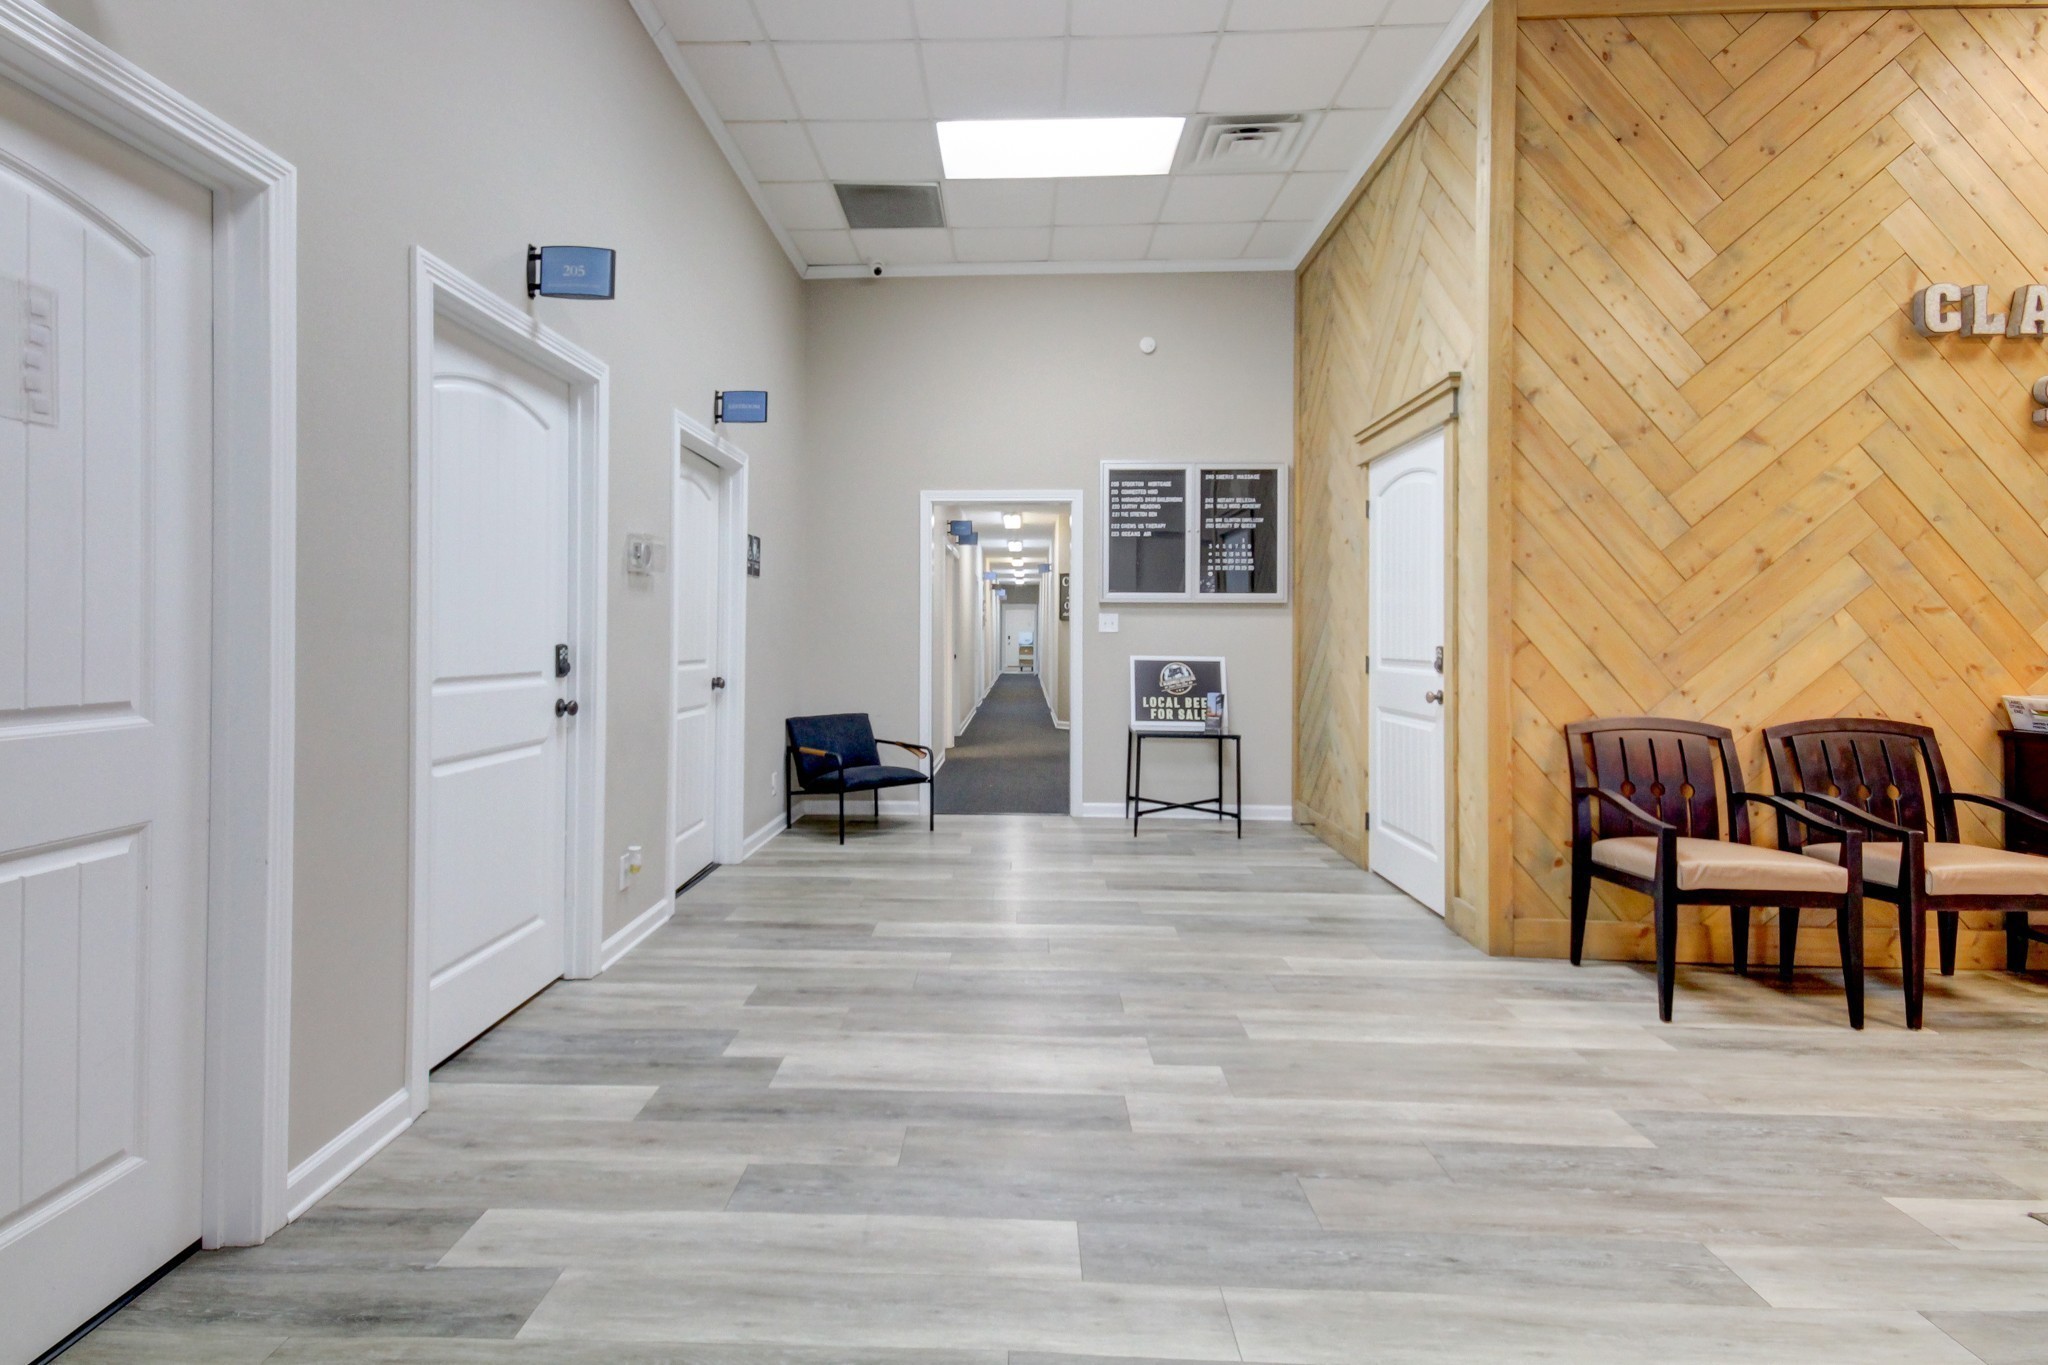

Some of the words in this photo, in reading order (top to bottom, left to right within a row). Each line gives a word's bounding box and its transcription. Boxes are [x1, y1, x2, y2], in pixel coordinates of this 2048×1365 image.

[562, 264, 586, 277] 205
[1142, 697, 1180, 708] LOCAL
[1185, 697, 1208, 708] BEE
[1150, 708, 1174, 720] FOR
[1178, 708, 1207, 720] SALE
